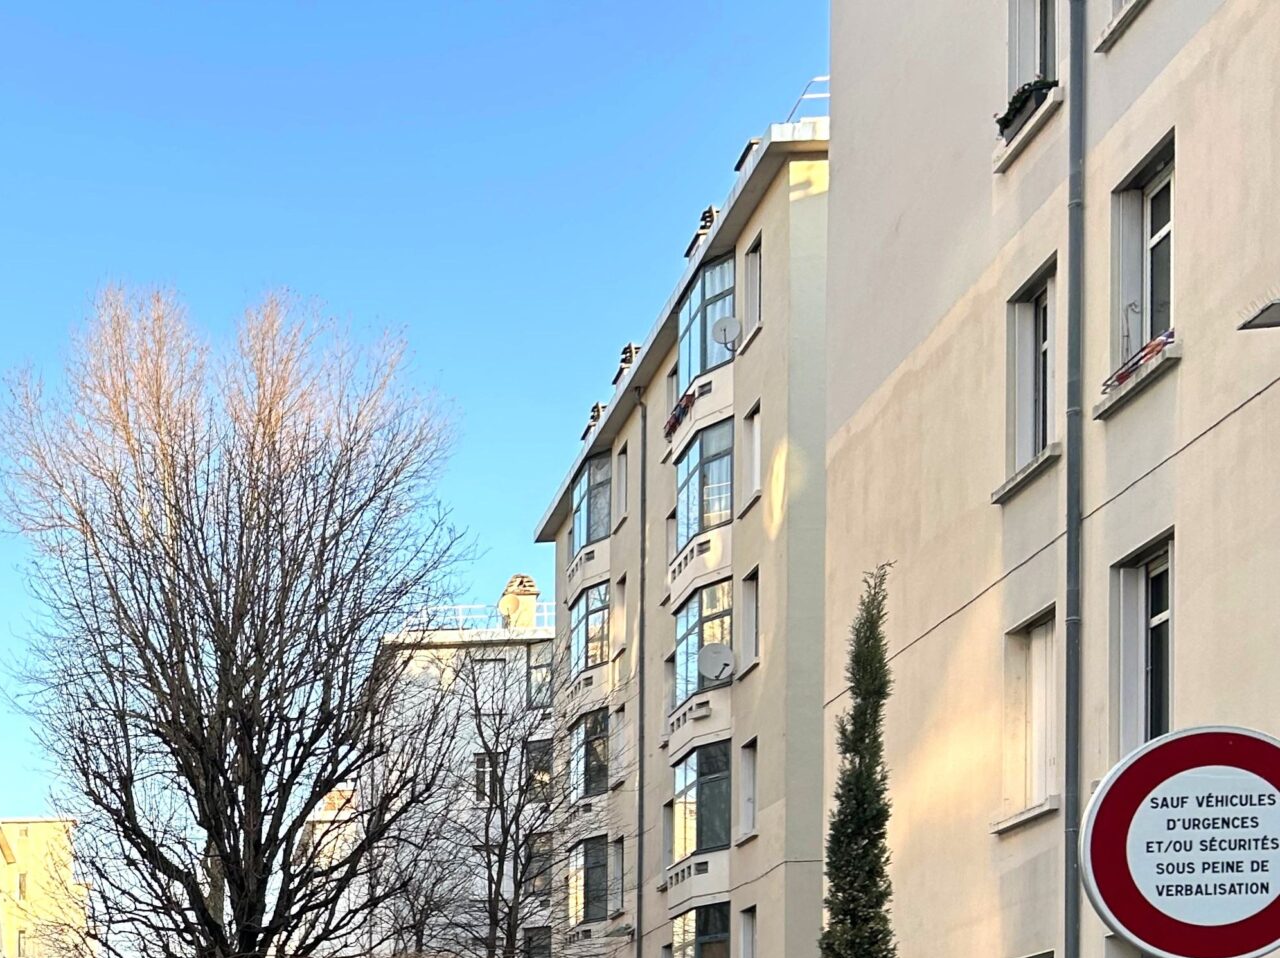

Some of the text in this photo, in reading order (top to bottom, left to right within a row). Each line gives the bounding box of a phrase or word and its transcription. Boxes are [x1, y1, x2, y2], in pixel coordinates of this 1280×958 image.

[1149, 793, 1277, 810] SAUF VÉHICULES
[1166, 816, 1260, 831] D'URGENCES
[1145, 835, 1280, 854] ET/OU SÉCURITÉS
[1155, 859, 1270, 875] SOUS PEINE DE
[1155, 881, 1270, 897] VERBALISATION
